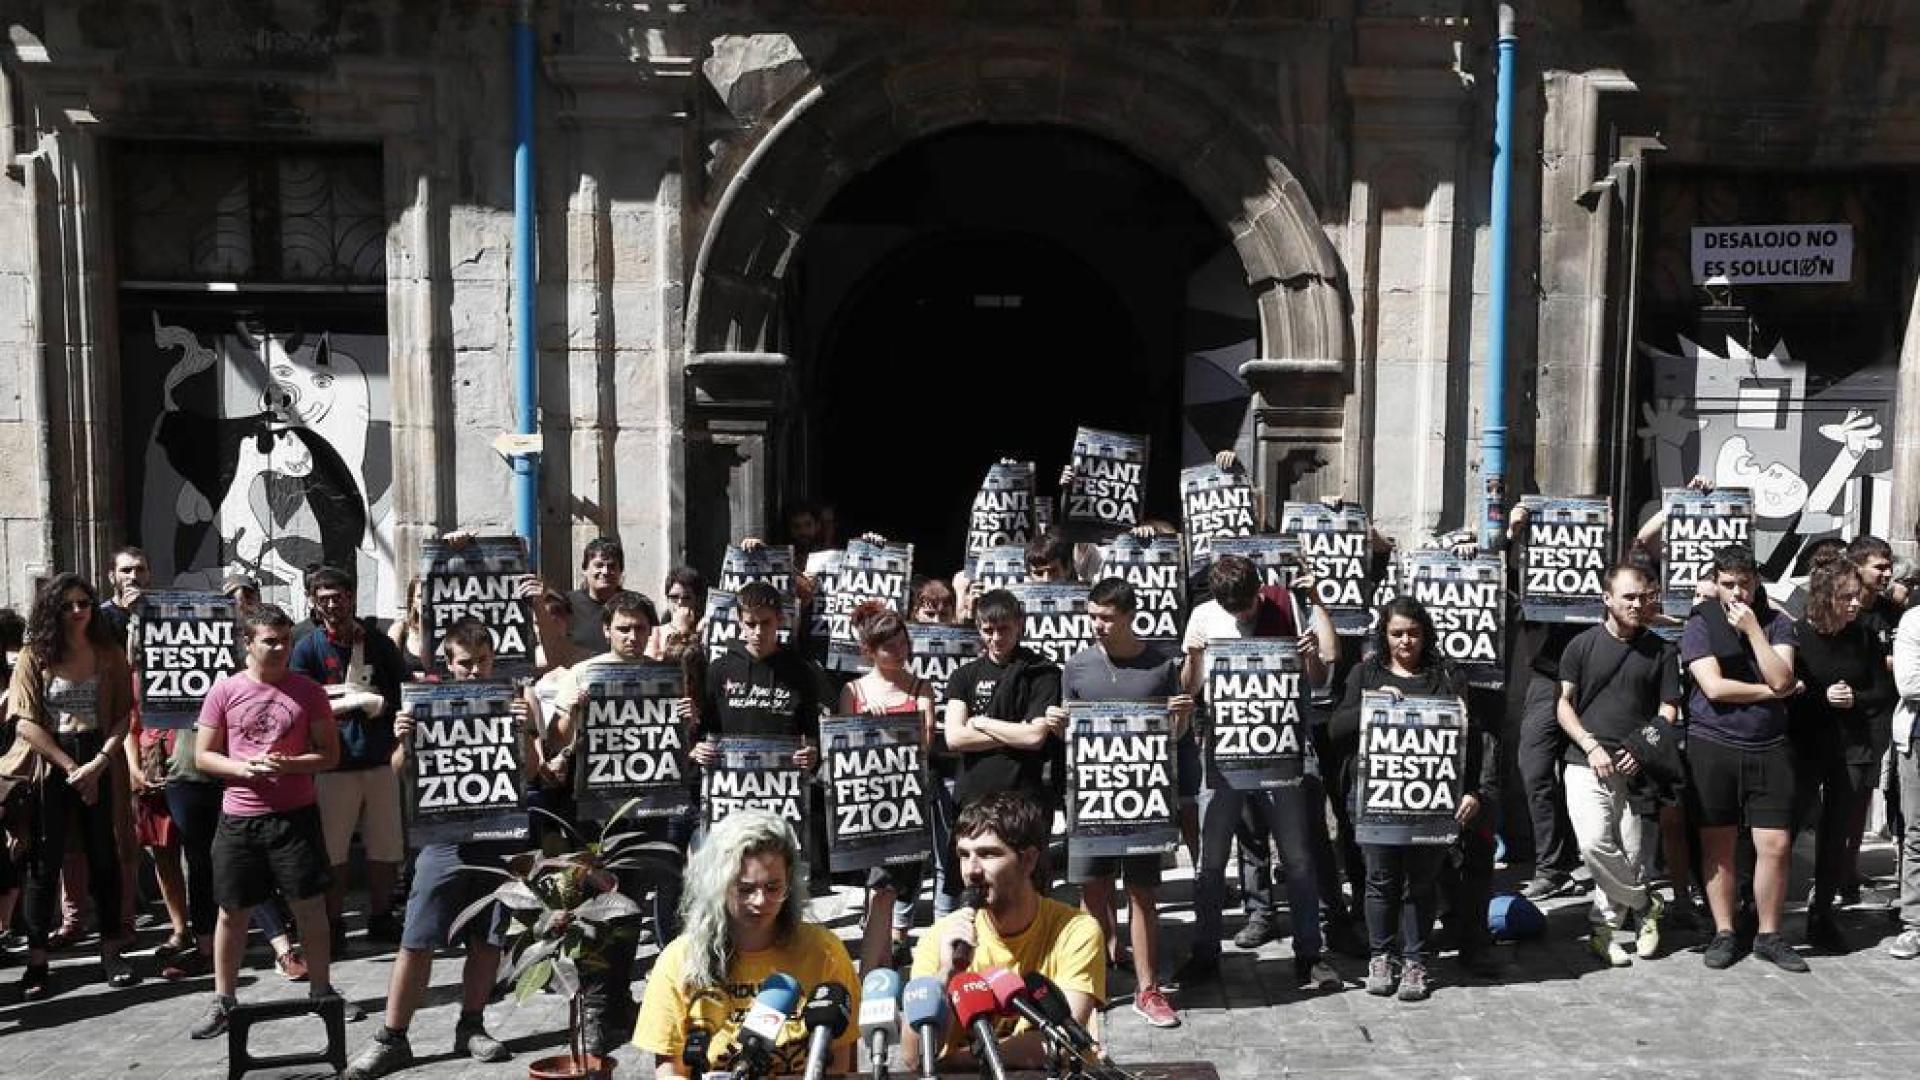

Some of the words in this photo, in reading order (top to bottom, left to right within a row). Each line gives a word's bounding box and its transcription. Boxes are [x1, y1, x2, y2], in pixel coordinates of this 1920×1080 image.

[1704, 230, 1801, 249] DESALOJO
[1807, 230, 1838, 247] NO
[1704, 260, 1725, 277] ES
[1080, 457, 1141, 484] MANI
[1072, 477, 1139, 503] FESTA
[1190, 488, 1251, 514] MANI
[973, 511, 1029, 531] FESTA
[1070, 496, 1137, 524] ZIOA
[1190, 508, 1254, 534] FESTA
[1528, 525, 1605, 548] MANI
[1670, 517, 1748, 540] MANI
[1528, 548, 1605, 569] FESTA
[1670, 540, 1743, 561] FES
[1527, 567, 1603, 594] ZIOA
[1670, 561, 1715, 586] ZI
[432, 575, 524, 602] MANI
[1134, 588, 1178, 610] STA
[1416, 581, 1498, 608] MANI
[1131, 611, 1178, 635] OA
[1426, 607, 1497, 631] ESTA
[144, 621, 234, 645] MANI
[145, 647, 235, 668] FESTA
[1214, 673, 1300, 699] MANI
[587, 698, 680, 726] MANI
[1214, 700, 1300, 724] FESTA
[415, 716, 515, 749] MANI
[587, 725, 681, 753] FESTA
[1214, 725, 1300, 754] ZIOA
[1369, 726, 1459, 755] MANI
[417, 746, 517, 776] FESTA
[1077, 735, 1168, 762] MANI
[587, 752, 682, 782] ZIOA
[834, 745, 920, 779] MANI
[1369, 754, 1456, 780] FESTA
[711, 771, 801, 797] MANI
[835, 773, 922, 804] FESTA
[1077, 763, 1170, 789] FESTA
[418, 772, 519, 807] ZIOA
[1367, 780, 1455, 809] ZIOA
[837, 798, 924, 835] ZIOA
[1077, 788, 1170, 819] ZIOA
